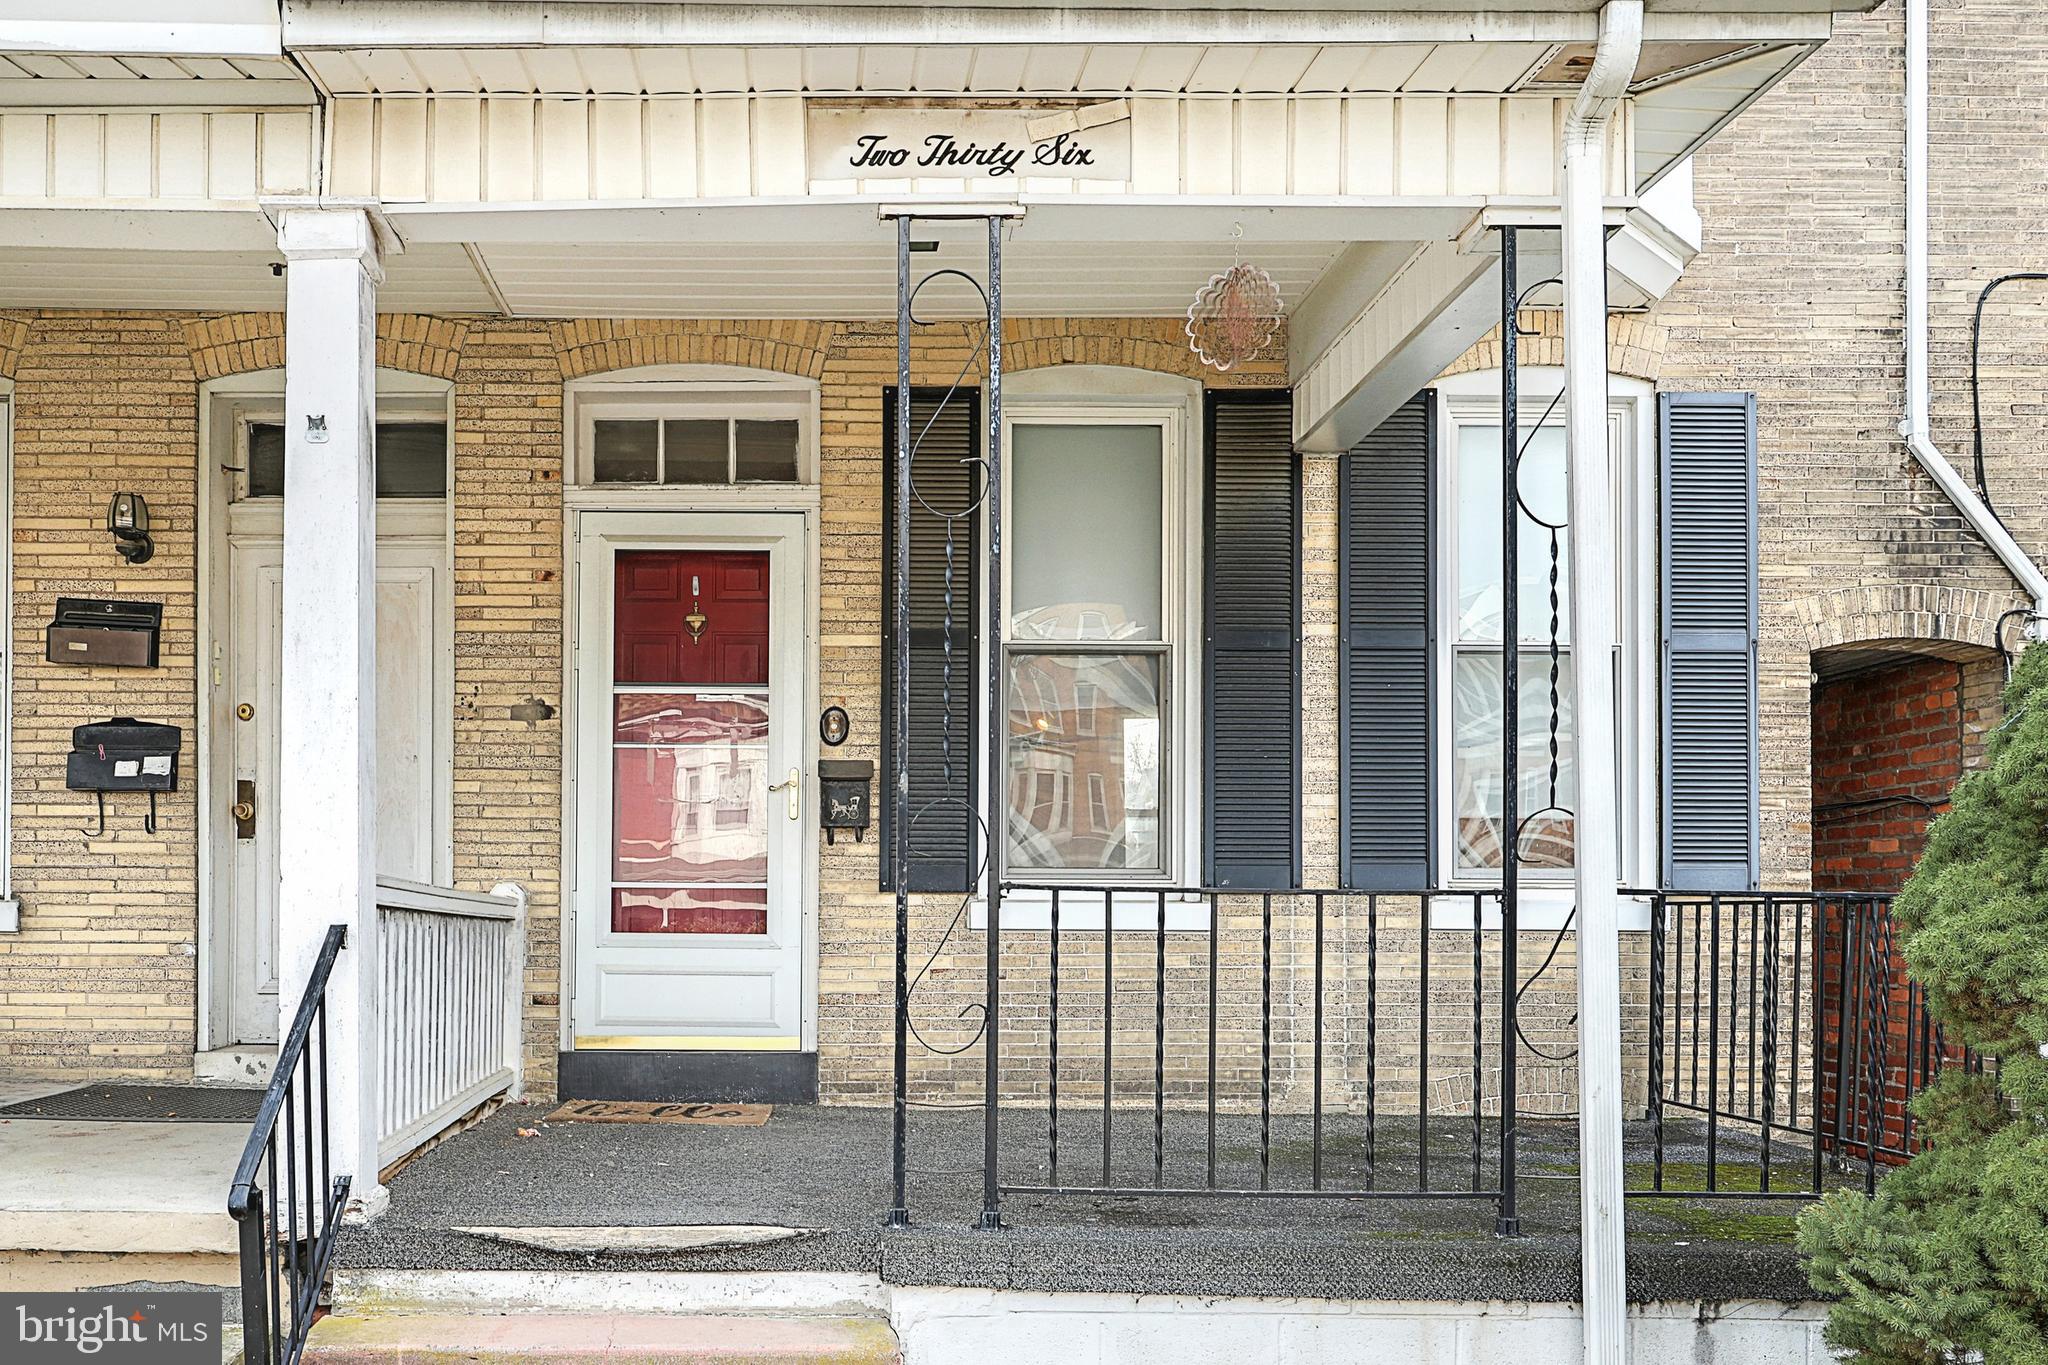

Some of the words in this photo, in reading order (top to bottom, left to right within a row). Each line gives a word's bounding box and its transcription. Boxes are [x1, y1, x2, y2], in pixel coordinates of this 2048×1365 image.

[850, 135, 910, 167] Two
[917, 134, 1026, 177] Thirty
[1031, 133, 1095, 166] Six
